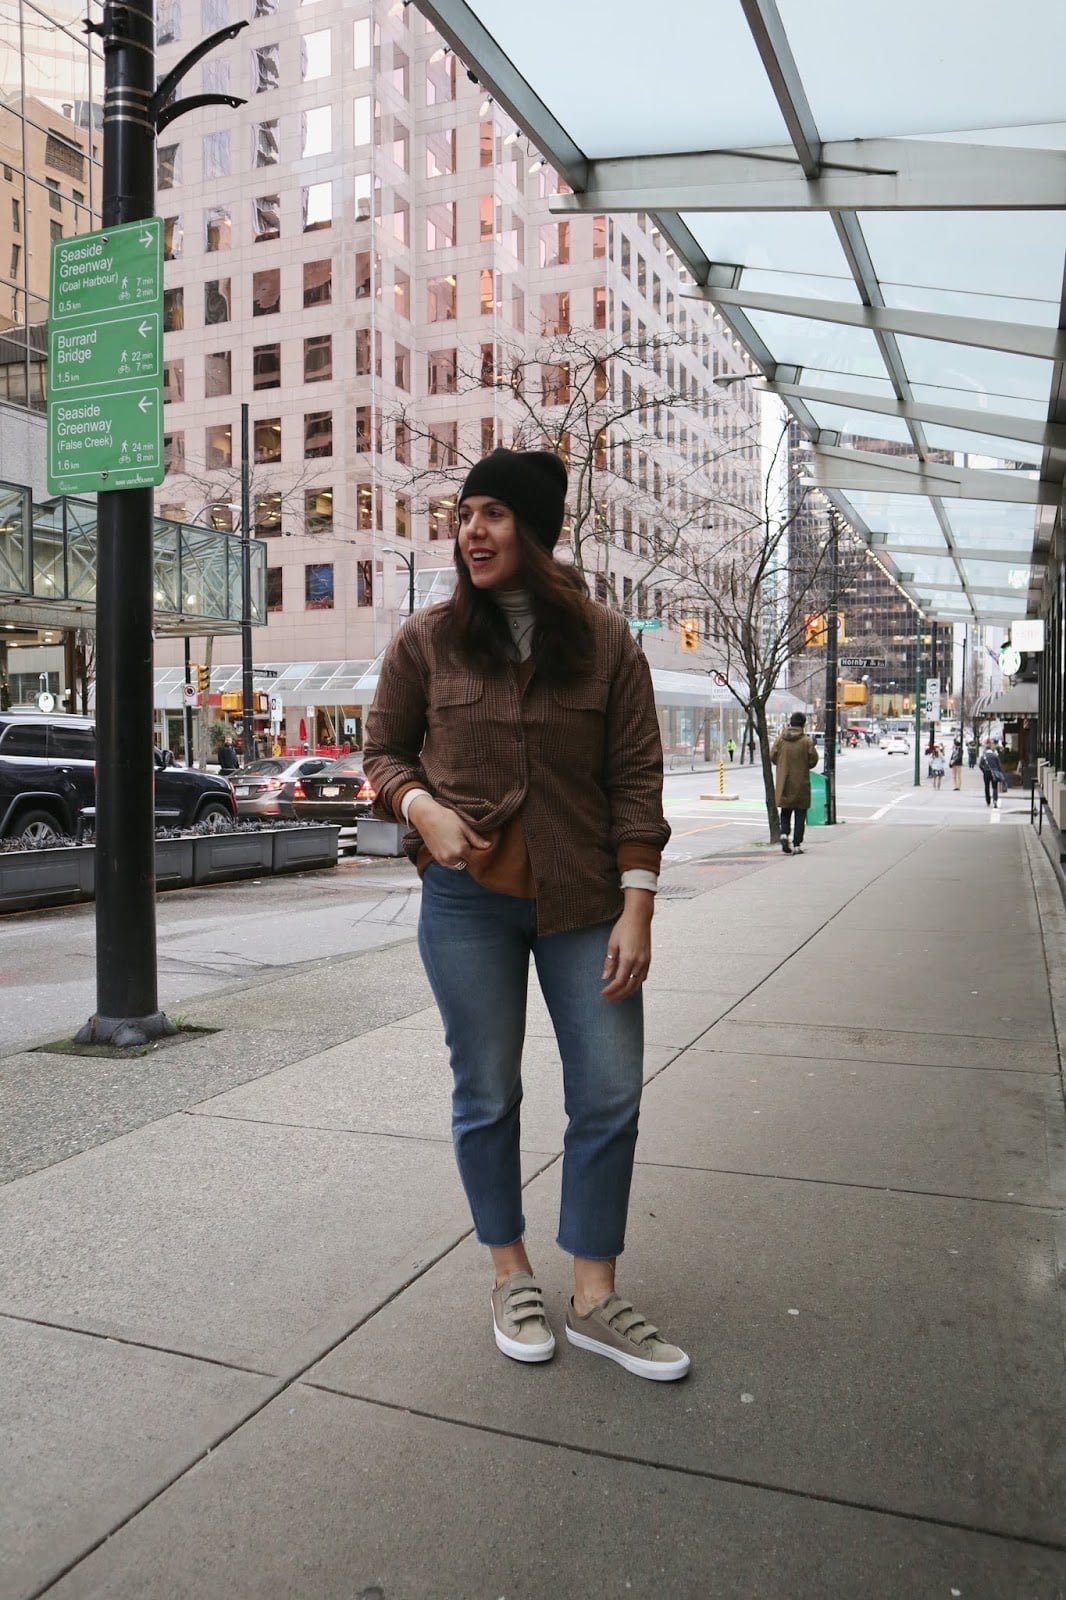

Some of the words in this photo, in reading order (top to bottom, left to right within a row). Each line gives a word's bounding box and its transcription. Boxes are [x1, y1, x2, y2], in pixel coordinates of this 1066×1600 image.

[60, 244, 102, 263] Seaside
[60, 257, 113, 277] Greenway
[59, 279, 81, 295] (Coal
[83, 272, 118, 287] Harbour)
[136, 278, 141, 286] 7
[142, 278, 153, 286] min
[136, 289, 141, 297] 2
[142, 288, 153, 296] min
[59, 300, 71, 312] 0.5
[72, 302, 81, 310] km
[58, 330, 96, 349] Burrard
[57, 348, 92, 363] Bridge
[131, 352, 141, 361] 22
[142, 352, 153, 360] min
[136, 363, 141, 371] 7
[58, 372, 70, 383] 1.5
[71, 374, 80, 382] km
[57, 404, 101, 421] Seaside
[57, 419, 112, 436] Greenway
[57, 439, 82, 453] (False
[85, 435, 113, 449] Creek)
[132, 442, 141, 452] 24
[142, 443, 154, 451] min
[136, 454, 142, 462] 8
[58, 459, 70, 470] 1.6
[842, 659, 867, 668] Hornby
